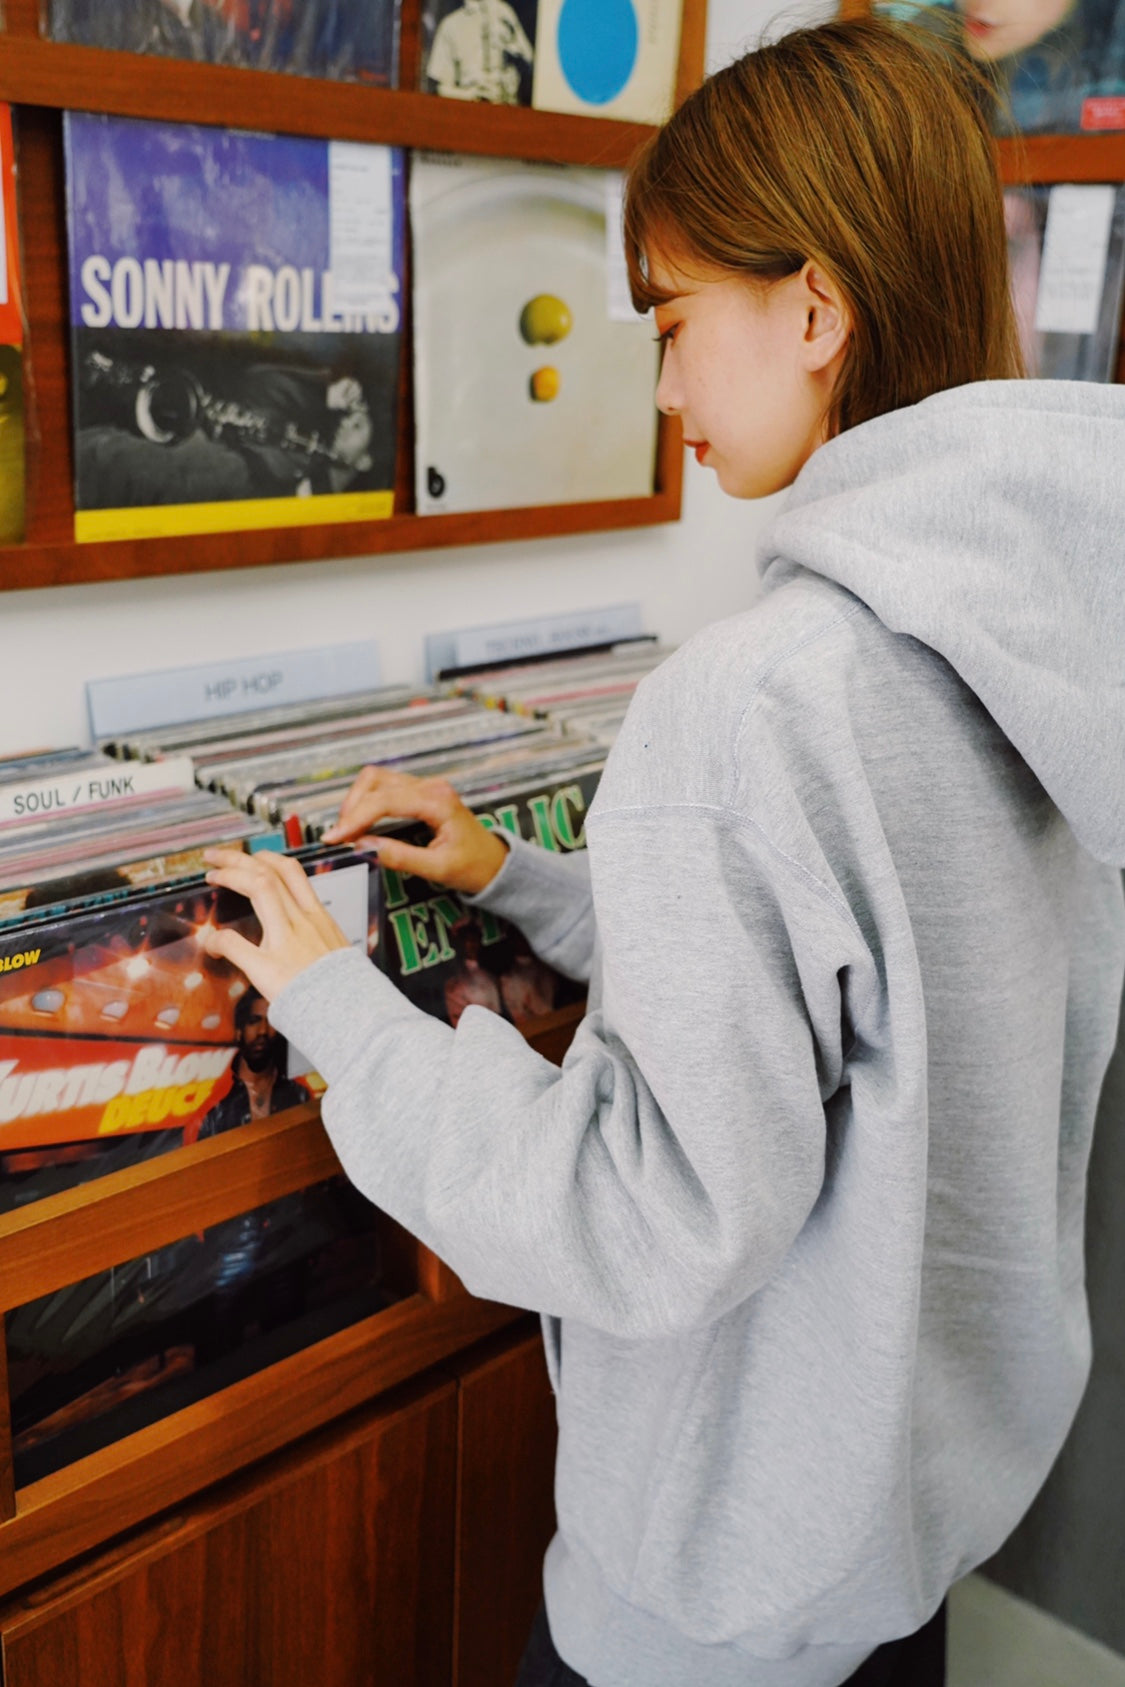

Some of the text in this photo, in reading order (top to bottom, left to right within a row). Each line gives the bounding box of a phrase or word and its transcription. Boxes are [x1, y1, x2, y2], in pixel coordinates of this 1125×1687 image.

[81, 255, 230, 330] SONNY
[204, 670, 284, 701] HIP HOP
[13, 776, 136, 815] SOUL / FUNK
[97, 1078, 217, 1134] DEUCE
